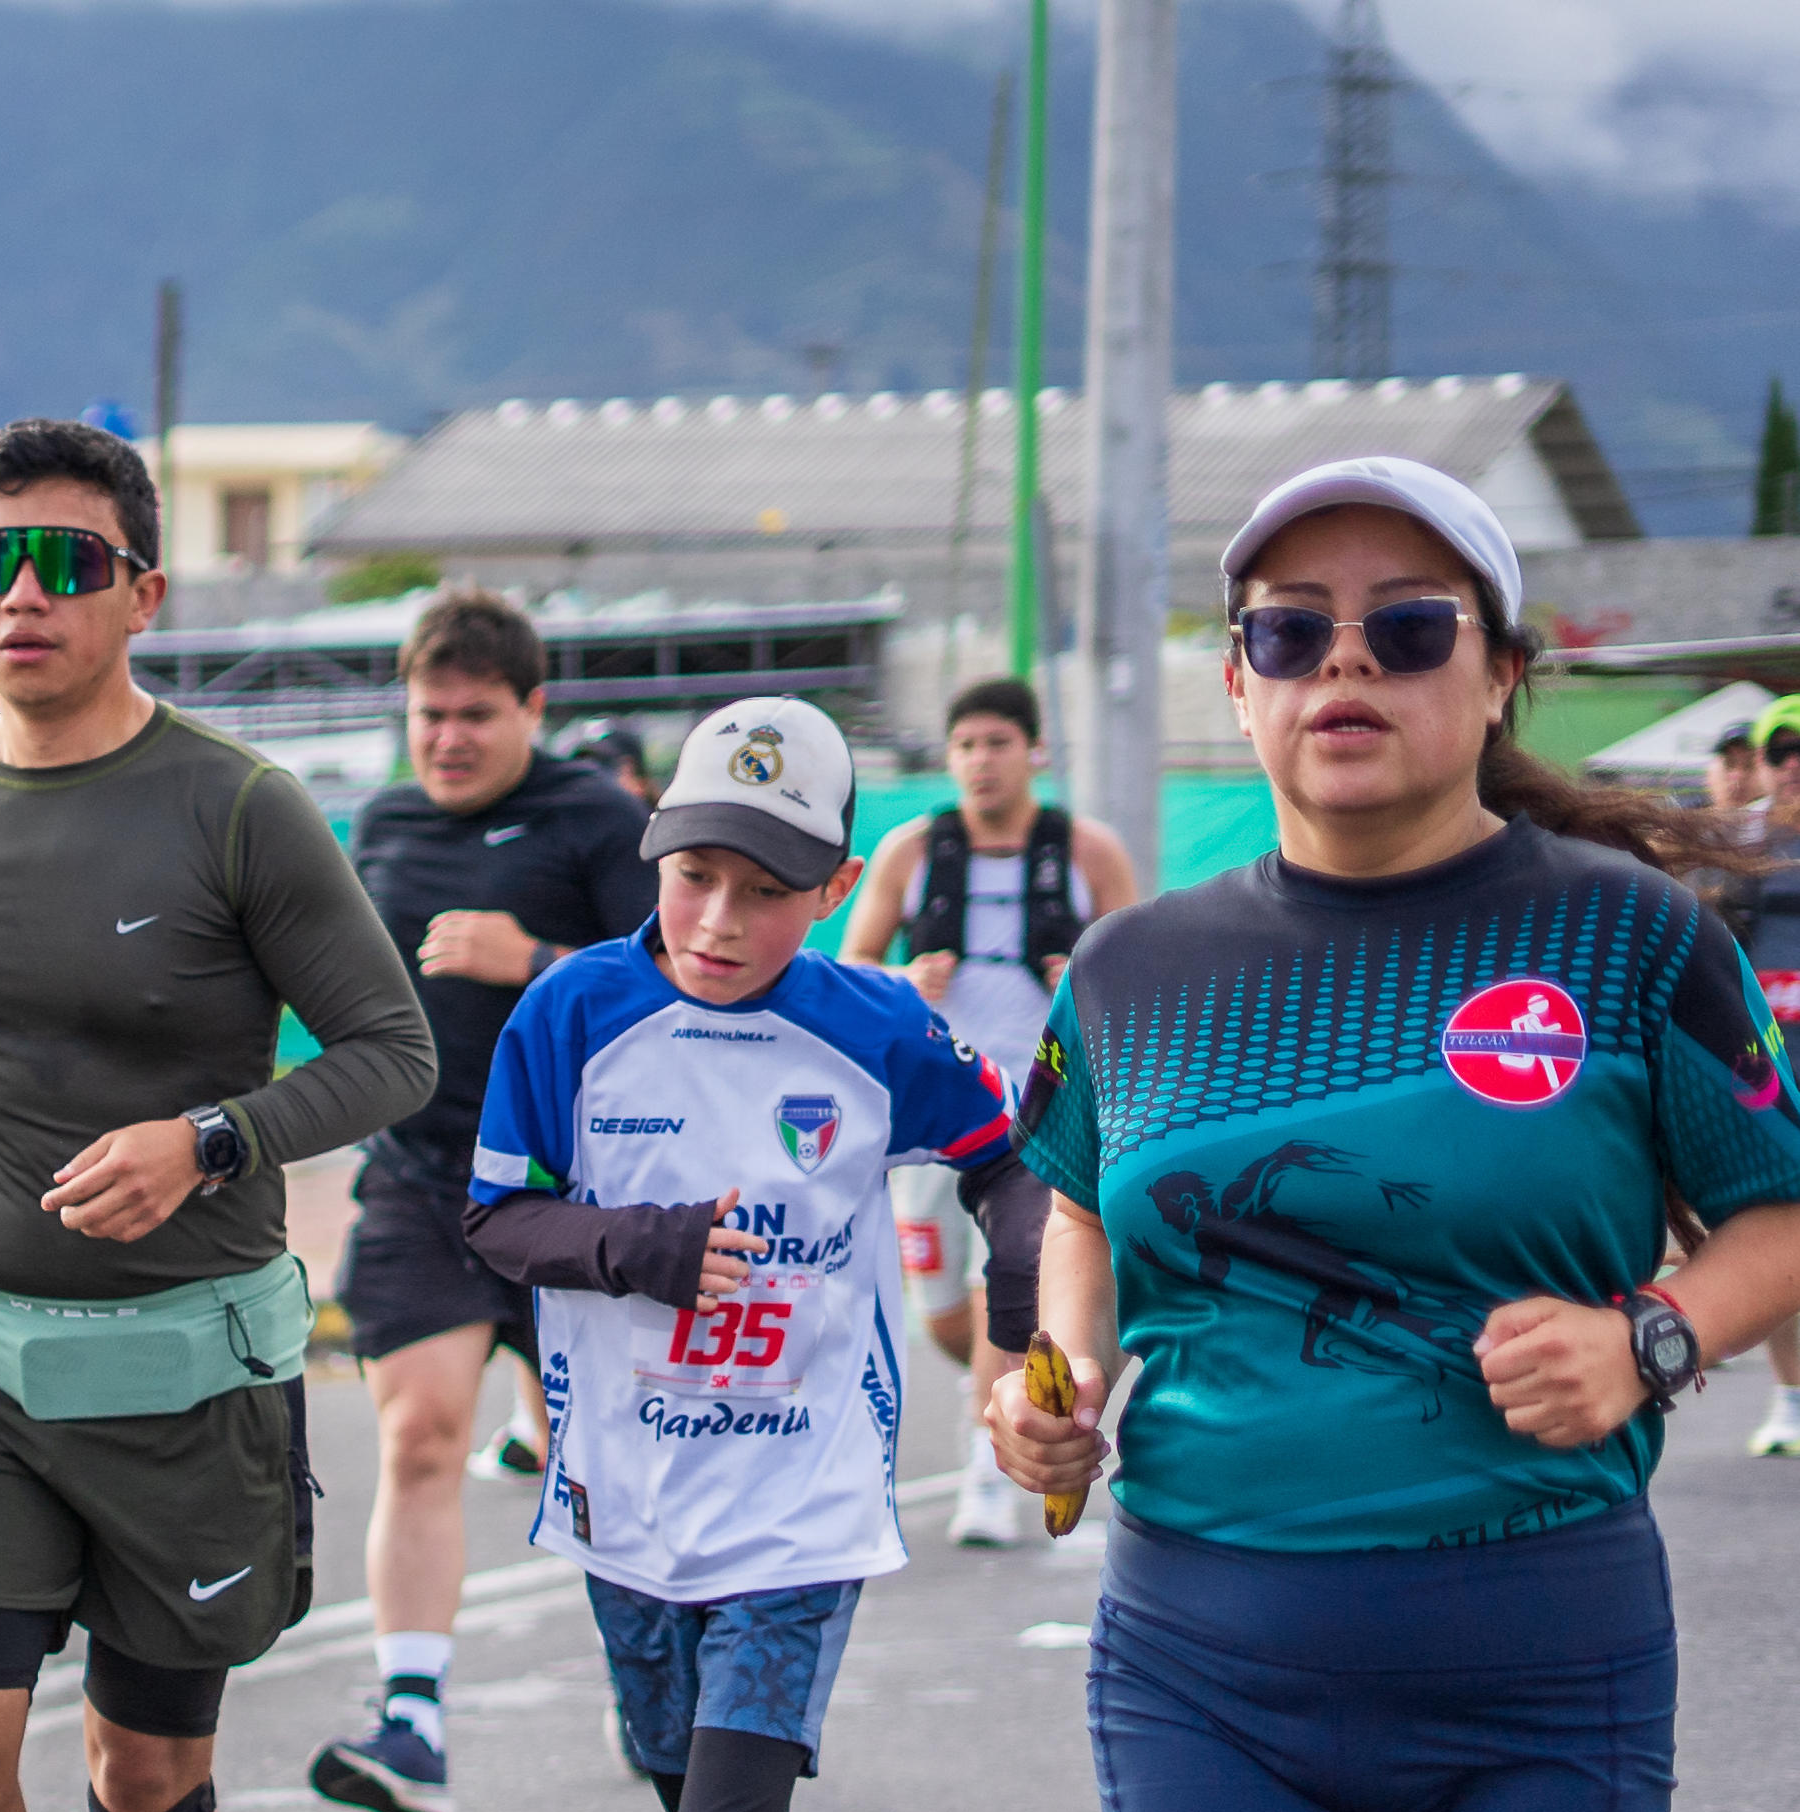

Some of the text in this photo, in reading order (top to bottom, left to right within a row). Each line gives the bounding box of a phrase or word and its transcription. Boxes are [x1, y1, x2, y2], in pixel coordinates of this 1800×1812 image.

[589, 1118, 685, 1134] DESIGN
[667, 1302, 793, 1367] 135
[711, 1375, 731, 1388] 5K
